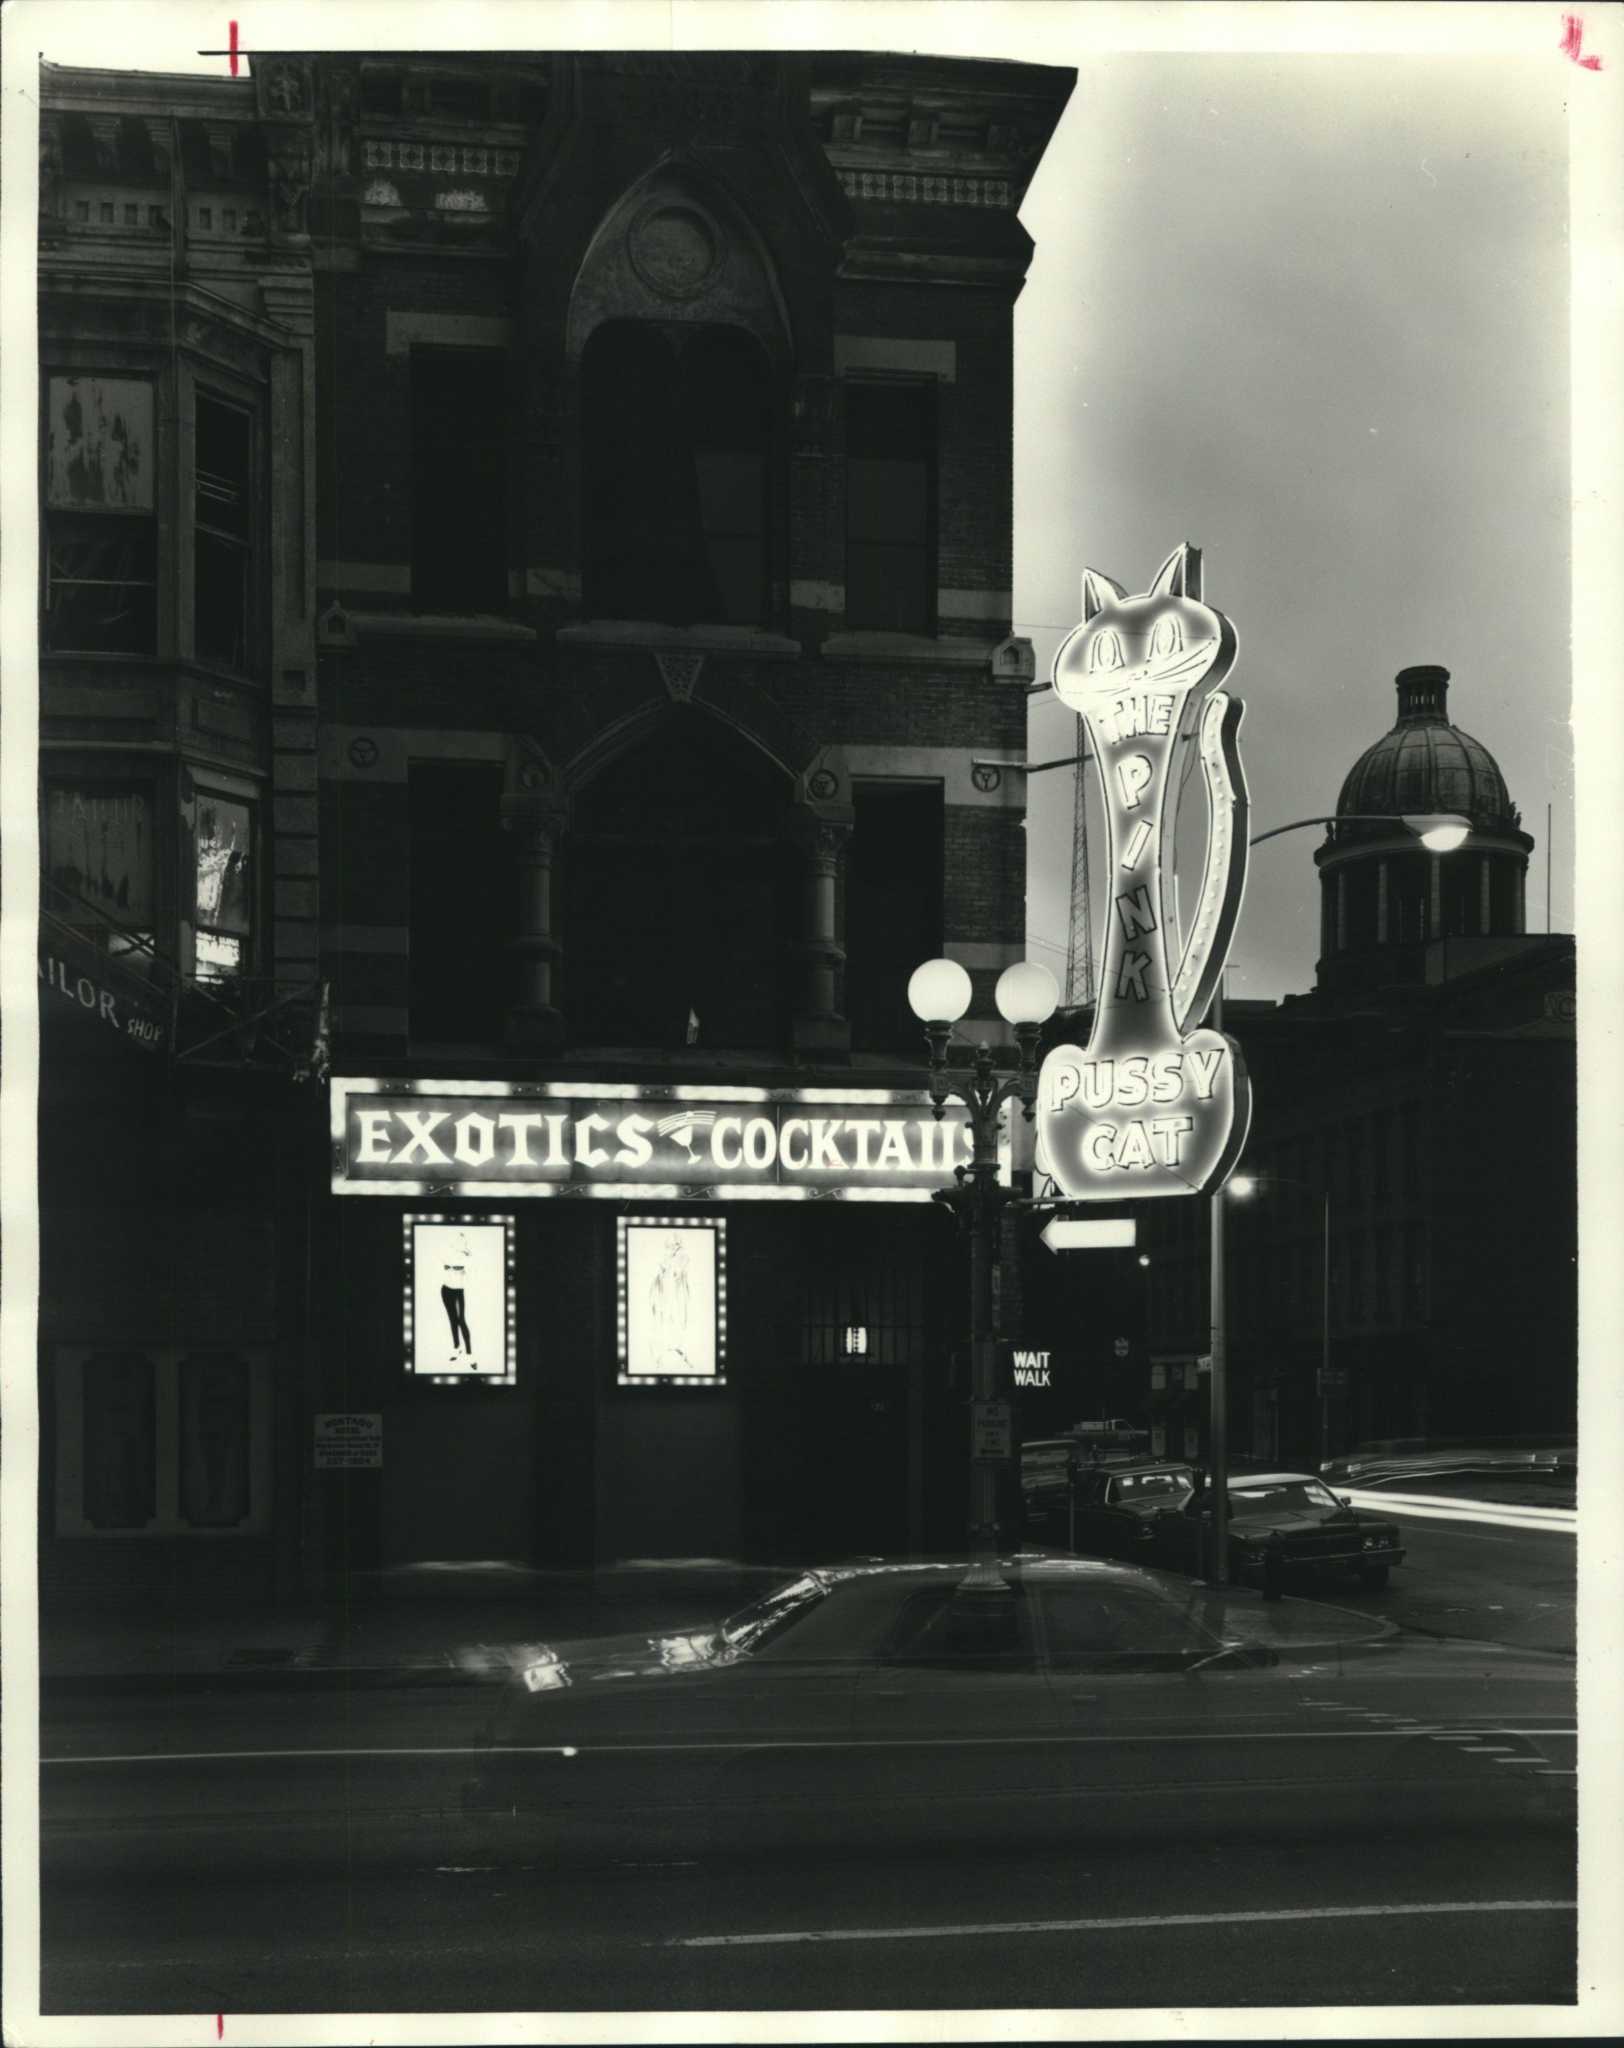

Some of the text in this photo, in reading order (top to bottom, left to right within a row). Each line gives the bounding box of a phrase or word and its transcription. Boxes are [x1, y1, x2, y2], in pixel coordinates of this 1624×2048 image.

[1100, 694, 1176, 745] THE
[1114, 753, 1158, 1002] PINK
[38, 956, 120, 1029] ILOR
[1050, 1047, 1226, 1113] PUSSY
[354, 1110, 655, 1169] EXOTICS
[1085, 1115, 1194, 1171] CAT
[1013, 1351, 1051, 1369] WAIT
[1013, 1369, 1051, 1387] WALK
